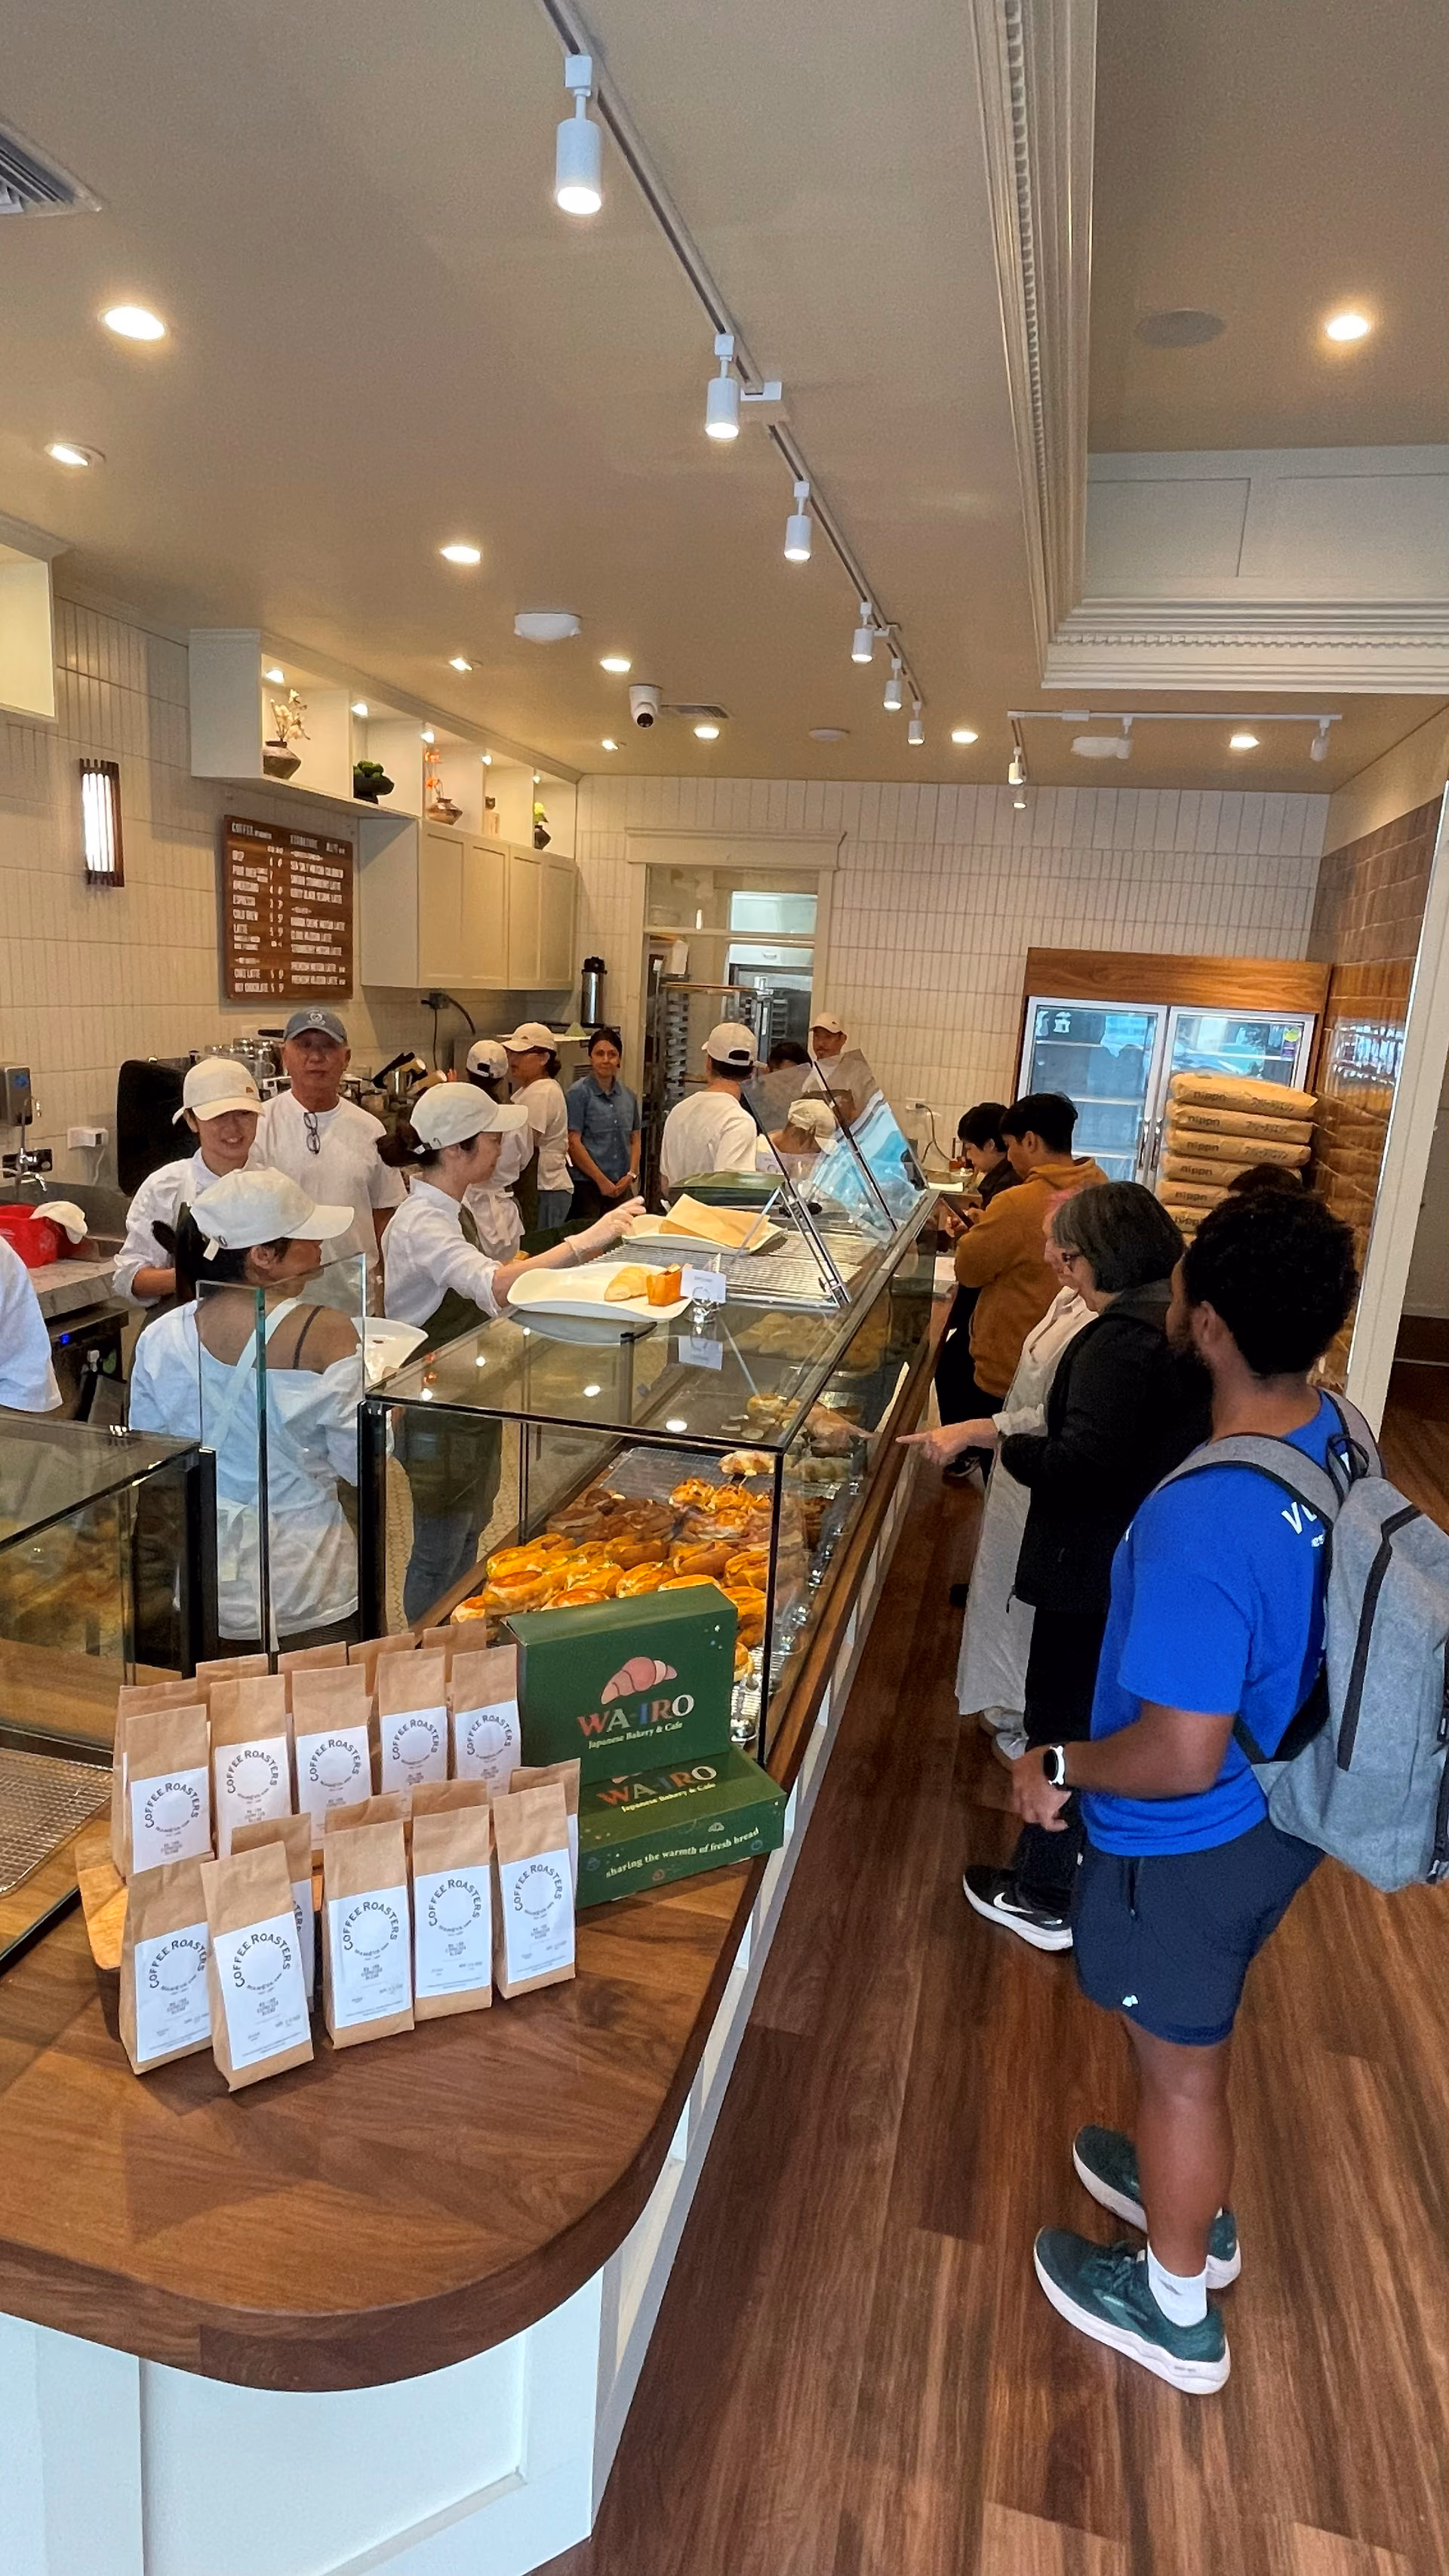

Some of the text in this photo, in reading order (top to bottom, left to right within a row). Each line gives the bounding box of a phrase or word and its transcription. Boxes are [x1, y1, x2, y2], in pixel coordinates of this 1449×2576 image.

[1188, 1116, 1220, 1127] nippn
[1186, 1141, 1219, 1152] nippn
[1180, 1165, 1212, 1175] nippn
[392, 1719, 439, 1760] COFFEE ROASTERS
[466, 1714, 512, 1756] COFFEE ROASTERS
[589, 1735, 625, 1750] Japanese
[626, 1728, 654, 1740] Bakery
[655, 1725, 663, 1734] &
[226, 1750, 278, 1794] COFFEE ROASTERS
[309, 1743, 328, 1782] COFFEE
[328, 1739, 361, 1775] ROASTERS
[145, 1788, 165, 1828] COFFEE
[165, 1782, 200, 1818] ROASTERS
[606, 1827, 759, 1878] sharing the warmth of fresh bread
[429, 1879, 481, 1927] COFFEE ROASTERS
[513, 1864, 563, 1911] COFFEE ROASTERS
[343, 1901, 399, 1951] COFFEE ROASTERS
[149, 1939, 207, 1989] COFFEE ROASTERS
[233, 1940, 251, 1988] COFFEE
[251, 1933, 292, 1970] ROASTERS
